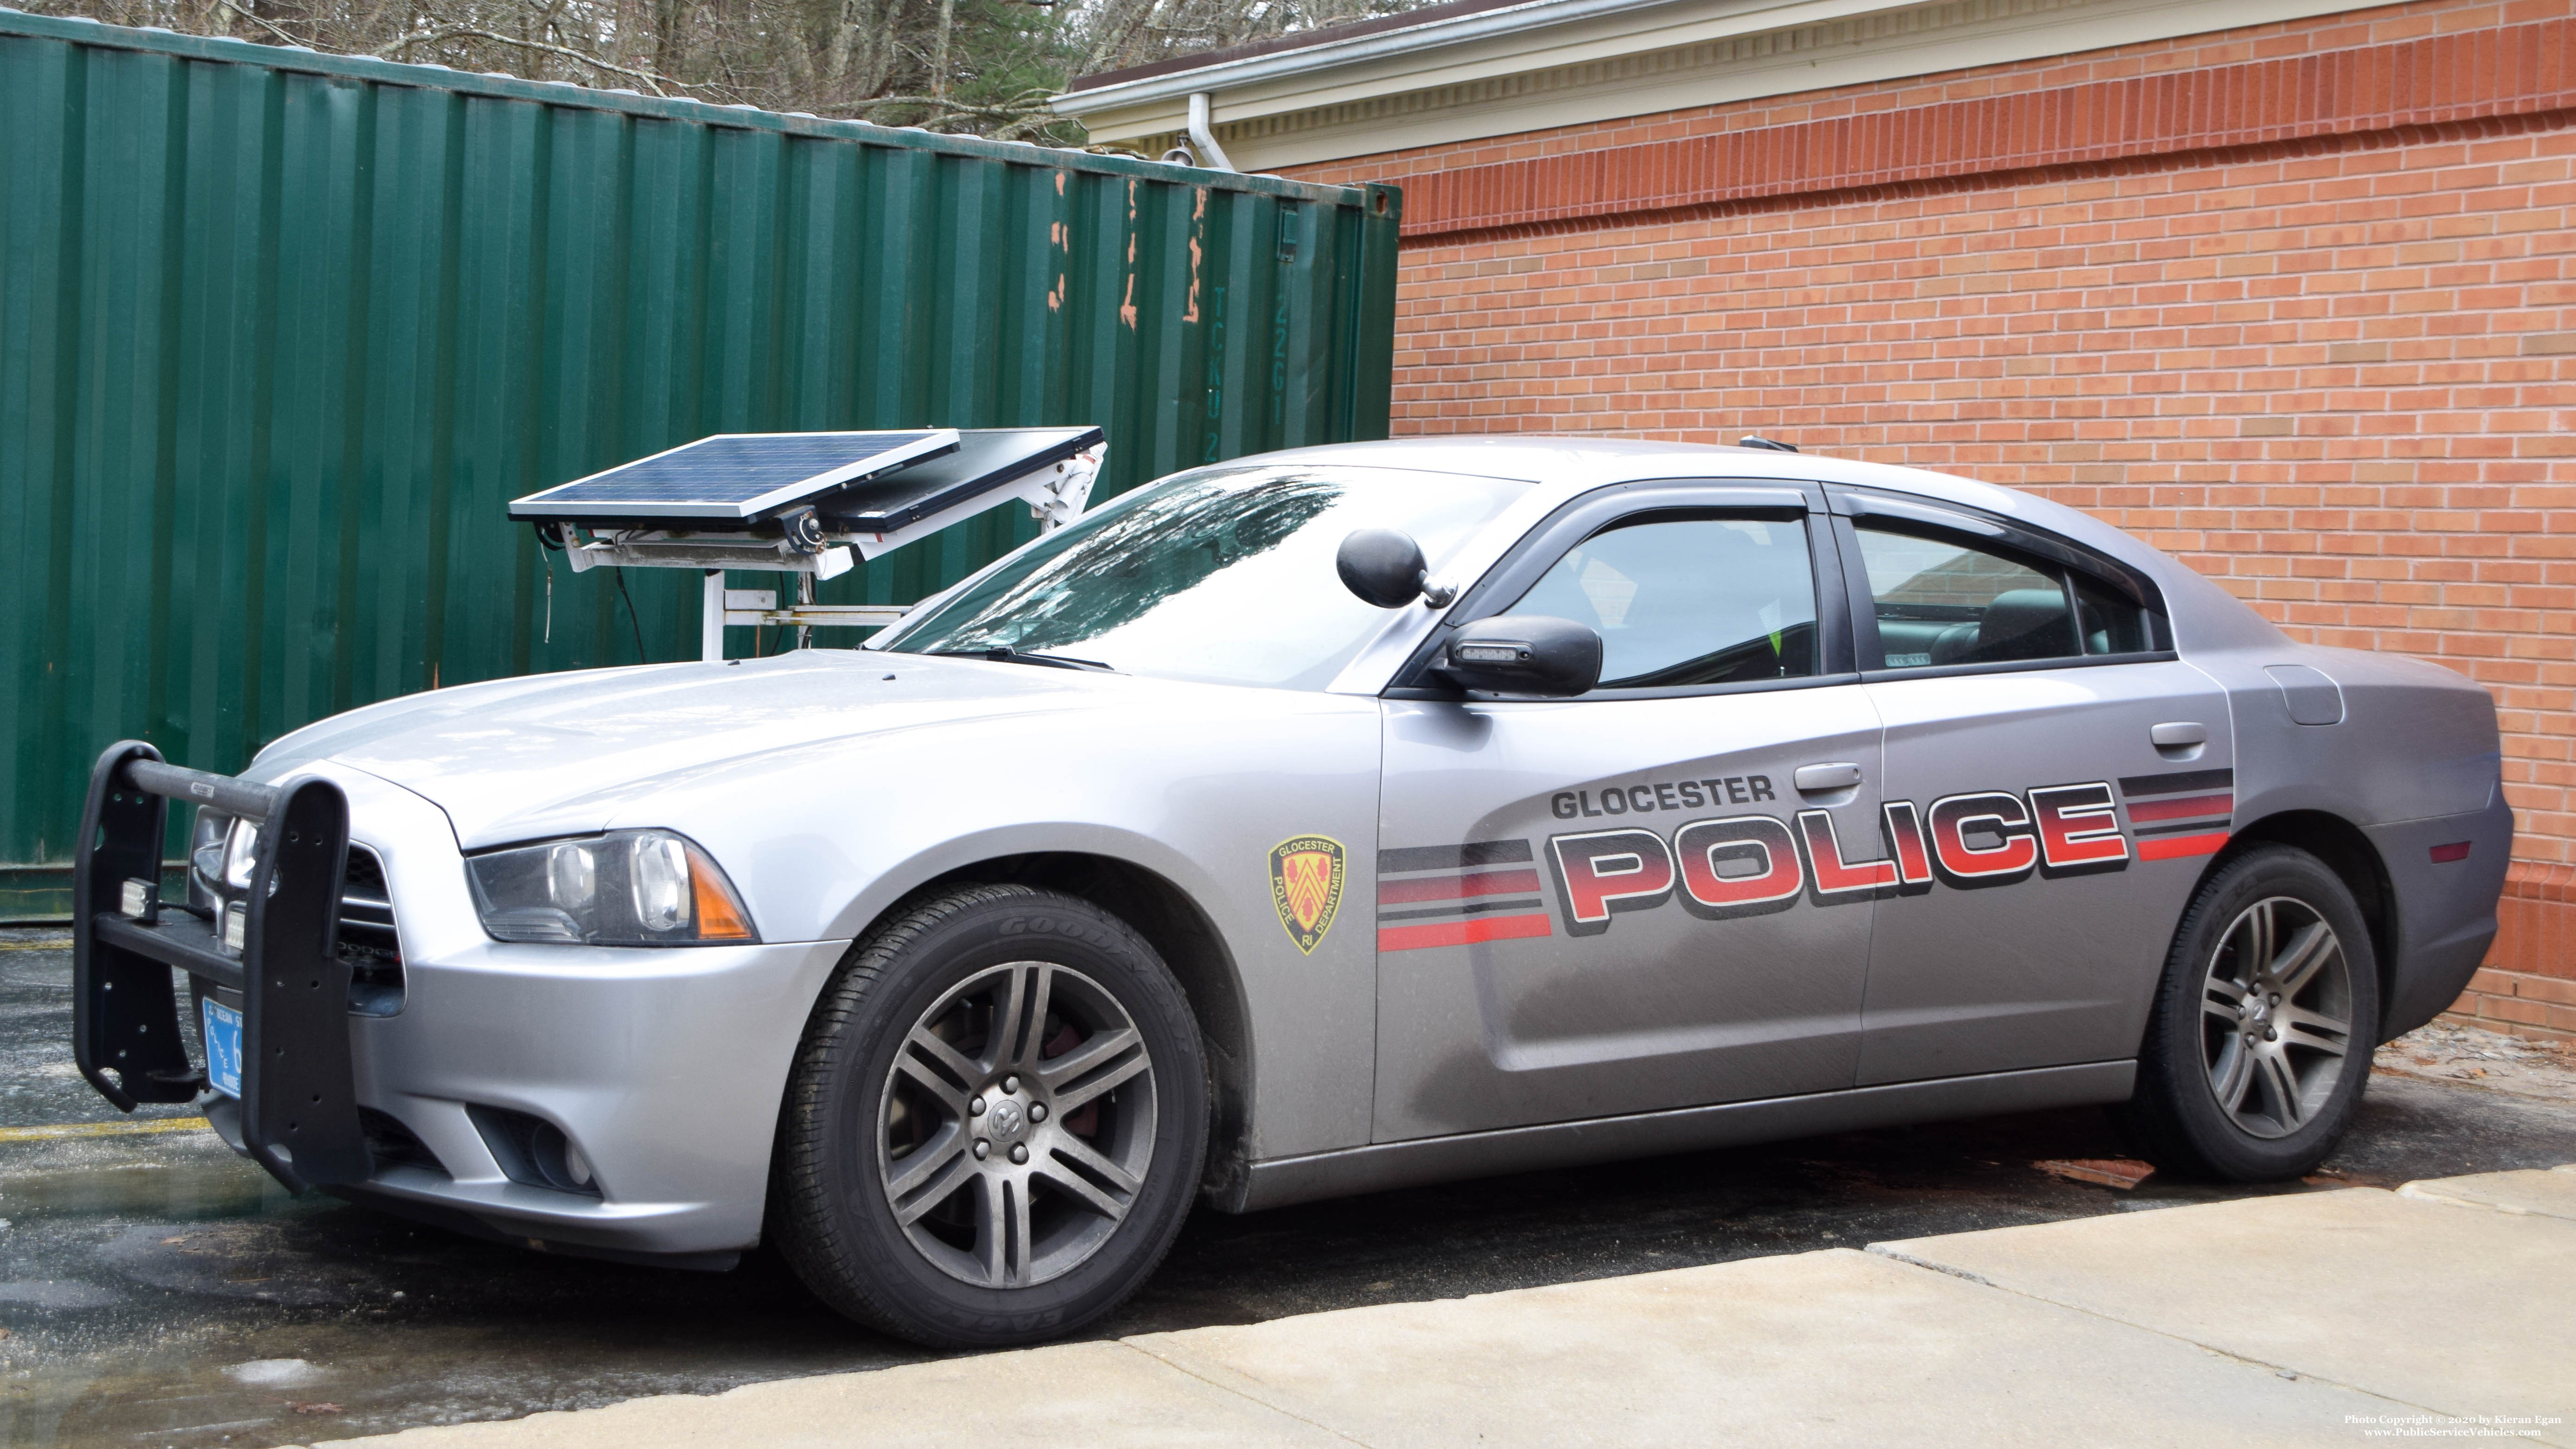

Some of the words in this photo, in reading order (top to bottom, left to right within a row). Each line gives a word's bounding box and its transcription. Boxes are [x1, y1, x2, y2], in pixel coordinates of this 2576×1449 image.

[1551, 775, 1776, 819] GLOCESTER
[1278, 840, 1335, 857] GLOCESTER
[1544, 780, 2130, 938] POLICE
[1274, 875, 1295, 925] POLICE
[1314, 856, 1341, 935] DEPARTMENT
[1302, 934, 1313, 946] RI
